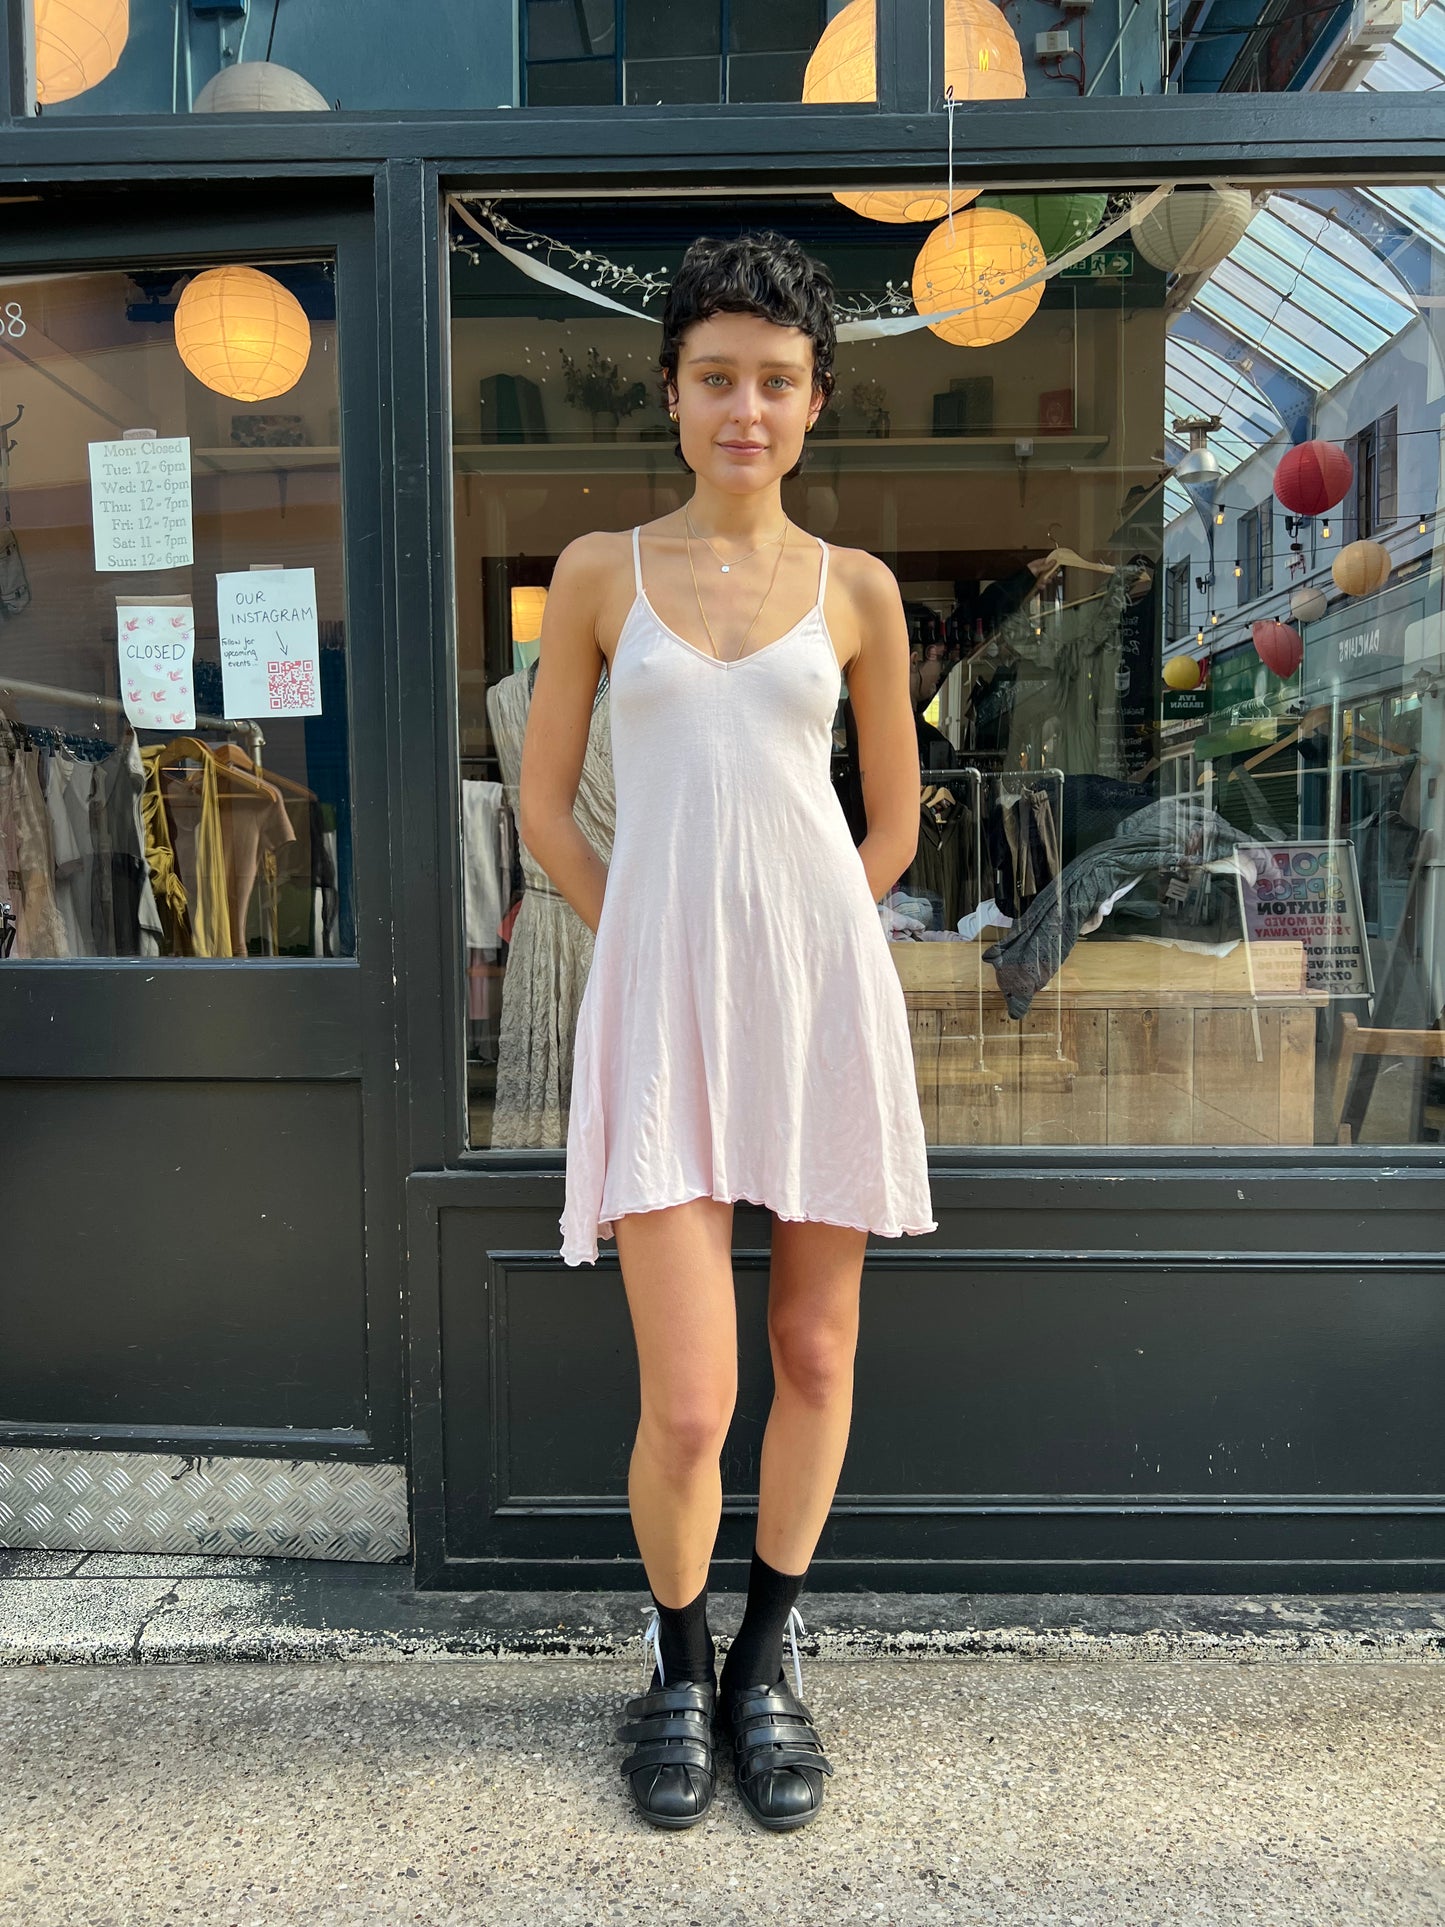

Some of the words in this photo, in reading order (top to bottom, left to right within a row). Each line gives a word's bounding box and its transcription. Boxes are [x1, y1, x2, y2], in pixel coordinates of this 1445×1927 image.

[103, 444, 137, 457] Mon:
[140, 442, 183, 455] Closed
[102, 463, 132, 476] Tue:
[135, 460, 150, 474] 12
[159, 460, 187, 475] 6pm
[101, 481, 137, 494] Wed:
[140, 479, 154, 493] 12
[163, 478, 190, 494] 6pm
[99, 500, 132, 513] Thu:
[140, 497, 154, 511] 12
[164, 497, 189, 512] 7pm
[111, 518, 134, 531] Fri:
[138, 516, 153, 530] 12
[162, 516, 187, 531] 7pm
[112, 537, 136, 549] Sat:
[140, 536, 153, 548] 11
[164, 534, 188, 549] 7pm
[107, 555, 137, 567] Sun:
[141, 553, 156, 567] 12
[165, 552, 190, 567] 6pm
[235, 590, 267, 605] OUR
[231, 607, 314, 624] INSTAGRAM
[221, 637, 242, 647] Follow
[244, 638, 256, 648] for
[126, 643, 186, 661] CLOSED
[223, 649, 258, 662] upcoming
